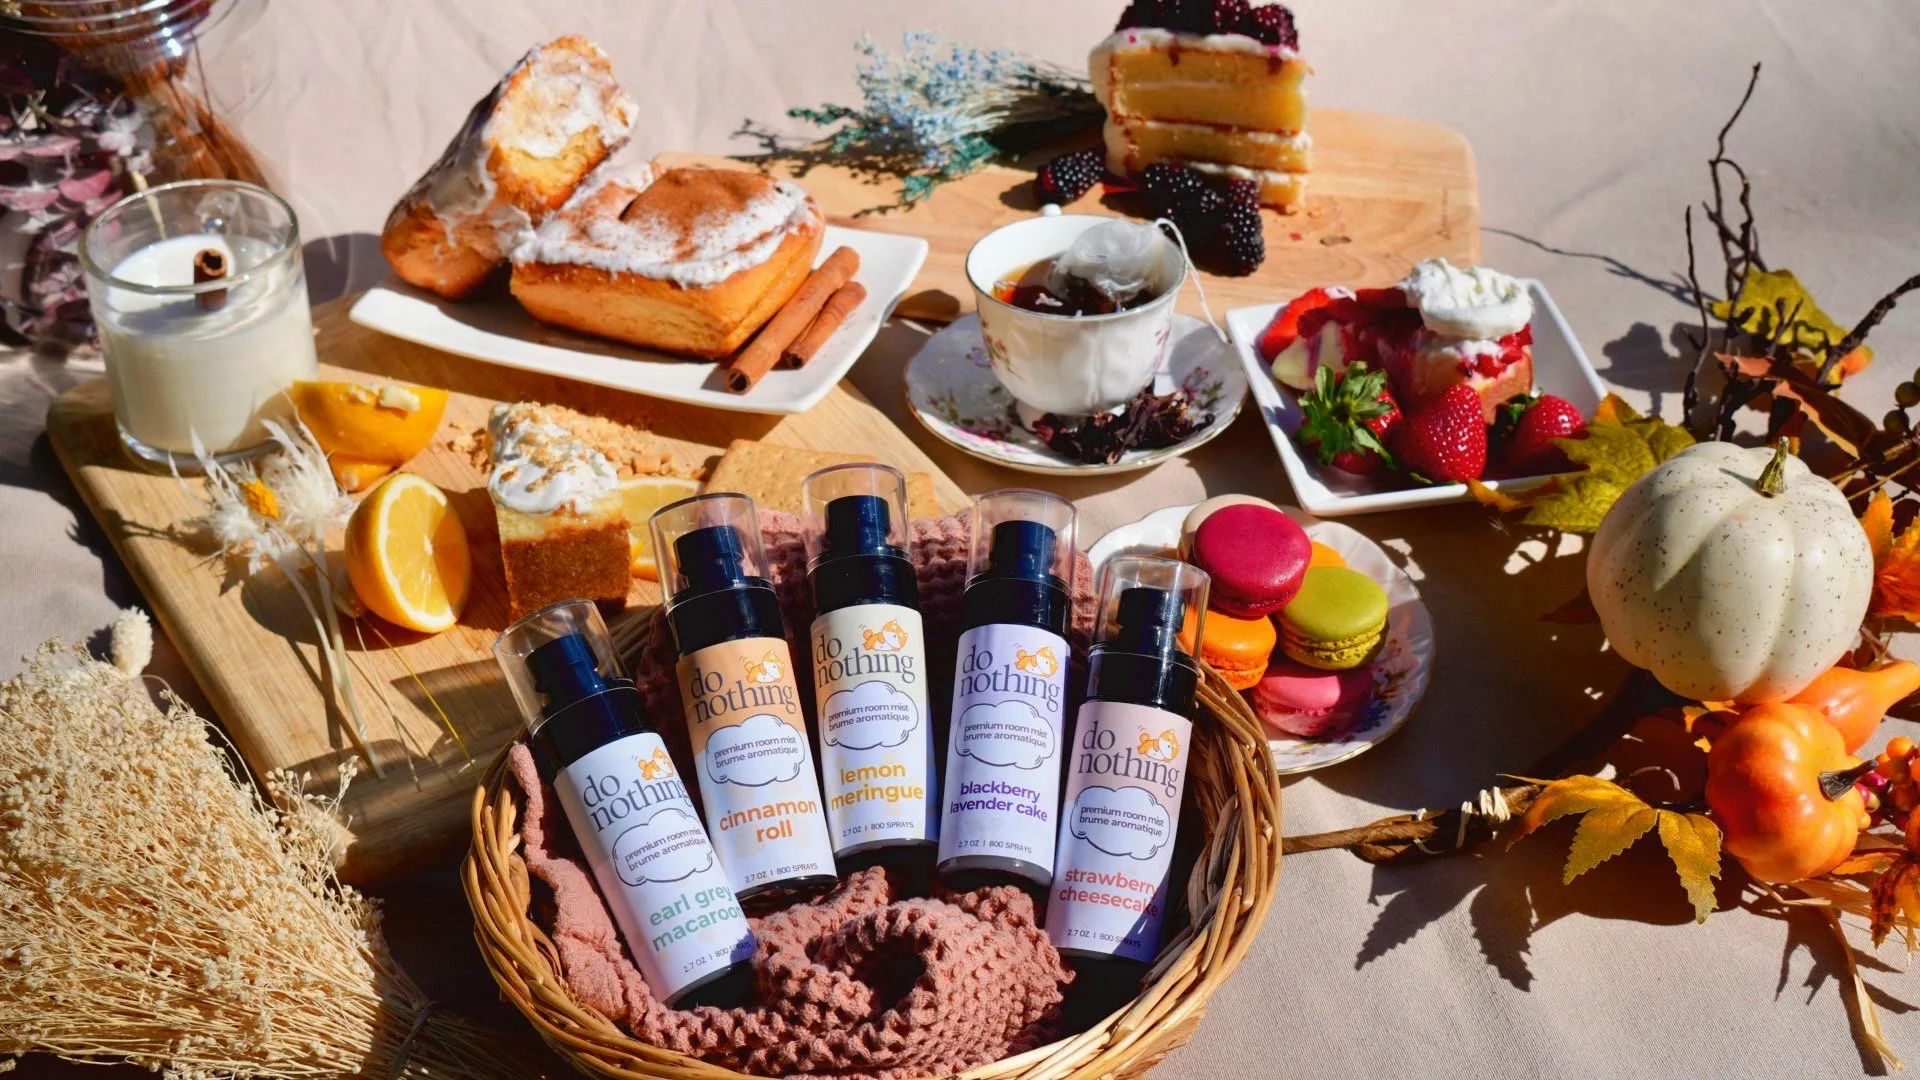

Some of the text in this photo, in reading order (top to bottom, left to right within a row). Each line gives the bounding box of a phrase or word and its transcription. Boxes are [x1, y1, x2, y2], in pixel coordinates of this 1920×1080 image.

[816, 633, 842, 665] do
[962, 644, 994, 674] do
[817, 646, 916, 688] nothing
[690, 667, 723, 699] do
[959, 664, 1061, 713] nothing
[694, 680, 797, 724] nothing
[828, 702, 909, 723] premium room mist
[829, 712, 910, 732] brume aromatique
[964, 721, 1048, 739] premium room mist
[1082, 720, 1116, 750] do
[713, 735, 796, 761] premium room mist
[963, 730, 1047, 748] brume aromatique
[715, 746, 799, 769] brume aromatique
[840, 763, 906, 785] lemon
[1077, 747, 1180, 798] nothing
[583, 774, 621, 808] do
[830, 783, 924, 811] meringue
[960, 780, 1041, 803] blackberry
[719, 799, 818, 832] cinnamon
[950, 797, 1048, 822] lavender cake
[1080, 805, 1165, 827] premium room mist
[756, 819, 793, 843] roll
[842, 828, 852, 837] 2.7
[852, 826, 862, 834] OZ
[870, 823, 885, 831] 800
[886, 821, 914, 829] SPRAYS
[1079, 815, 1163, 837] brume aromatique
[624, 837, 667, 864] premium
[666, 829, 690, 843] room
[958, 840, 968, 848] 2.7
[969, 839, 979, 847] OZ
[988, 840, 1004, 848] 800
[1004, 841, 1032, 854] SPRAYS
[627, 849, 661, 872] brume
[744, 873, 756, 883] 2.7
[756, 870, 768, 880] OZ
[776, 866, 791, 875] 800
[792, 862, 819, 872] SPRAYS
[1064, 868, 1159, 900] strawberry
[650, 885, 733, 926] earl grey
[1059, 886, 1159, 917] cheesecake
[1067, 928, 1078, 937] 2.7
[1079, 930, 1090, 938] OZ
[1099, 933, 1114, 942] 800
[683, 962, 695, 974] 2.7
[715, 947, 729, 959] 800
